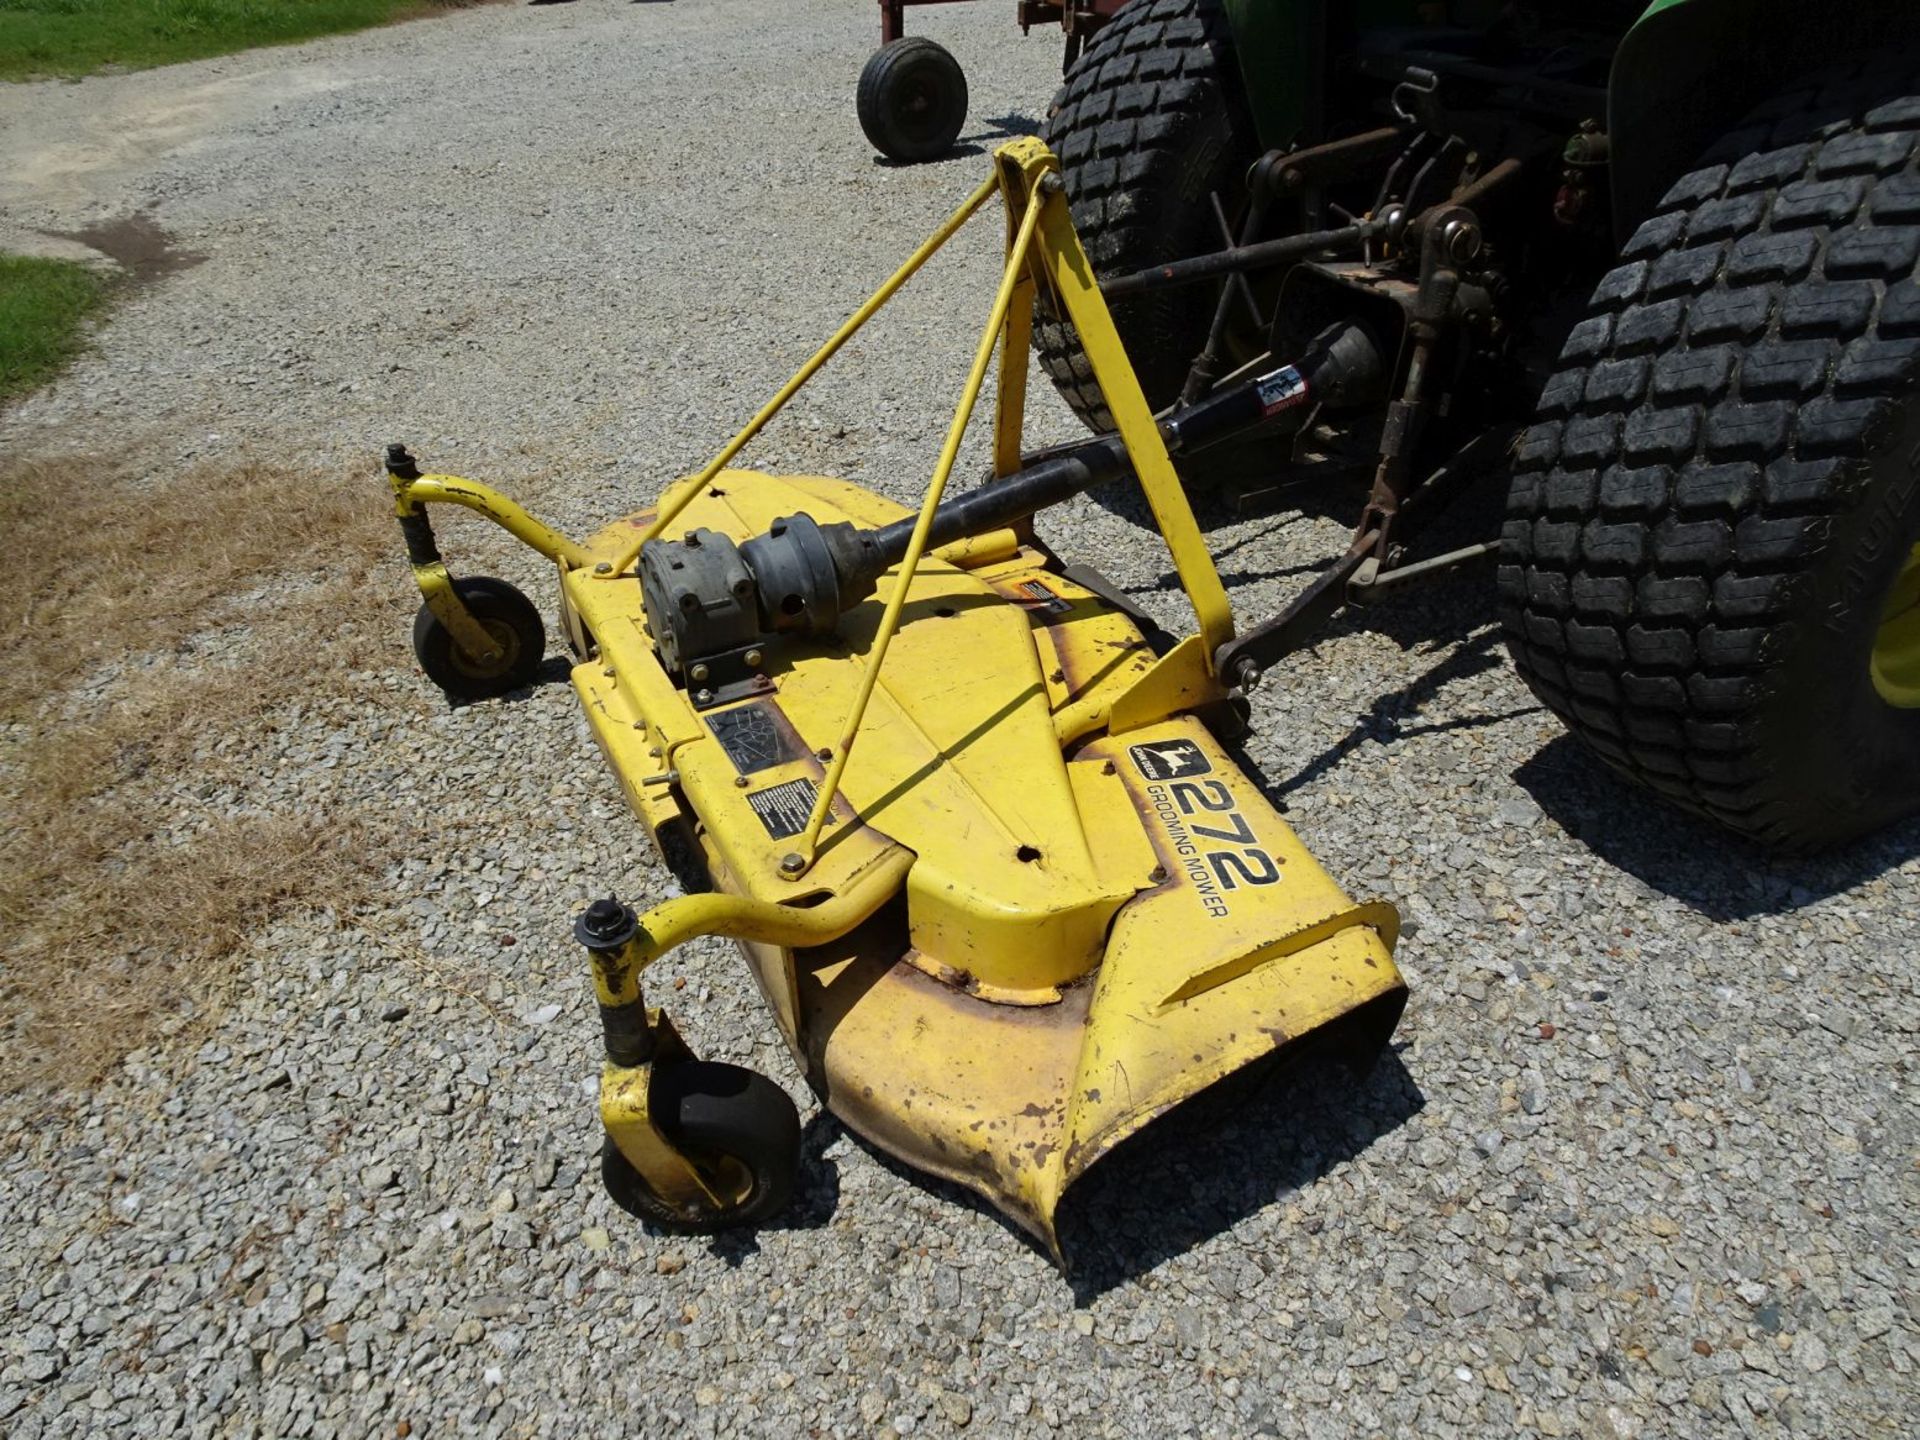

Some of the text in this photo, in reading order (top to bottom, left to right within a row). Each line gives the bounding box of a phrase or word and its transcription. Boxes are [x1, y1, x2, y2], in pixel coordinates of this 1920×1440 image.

[1141, 760, 1160, 780] DEERE
[1147, 784, 1228, 918] GROOMING MOWER
[1168, 779, 1281, 890] 272
